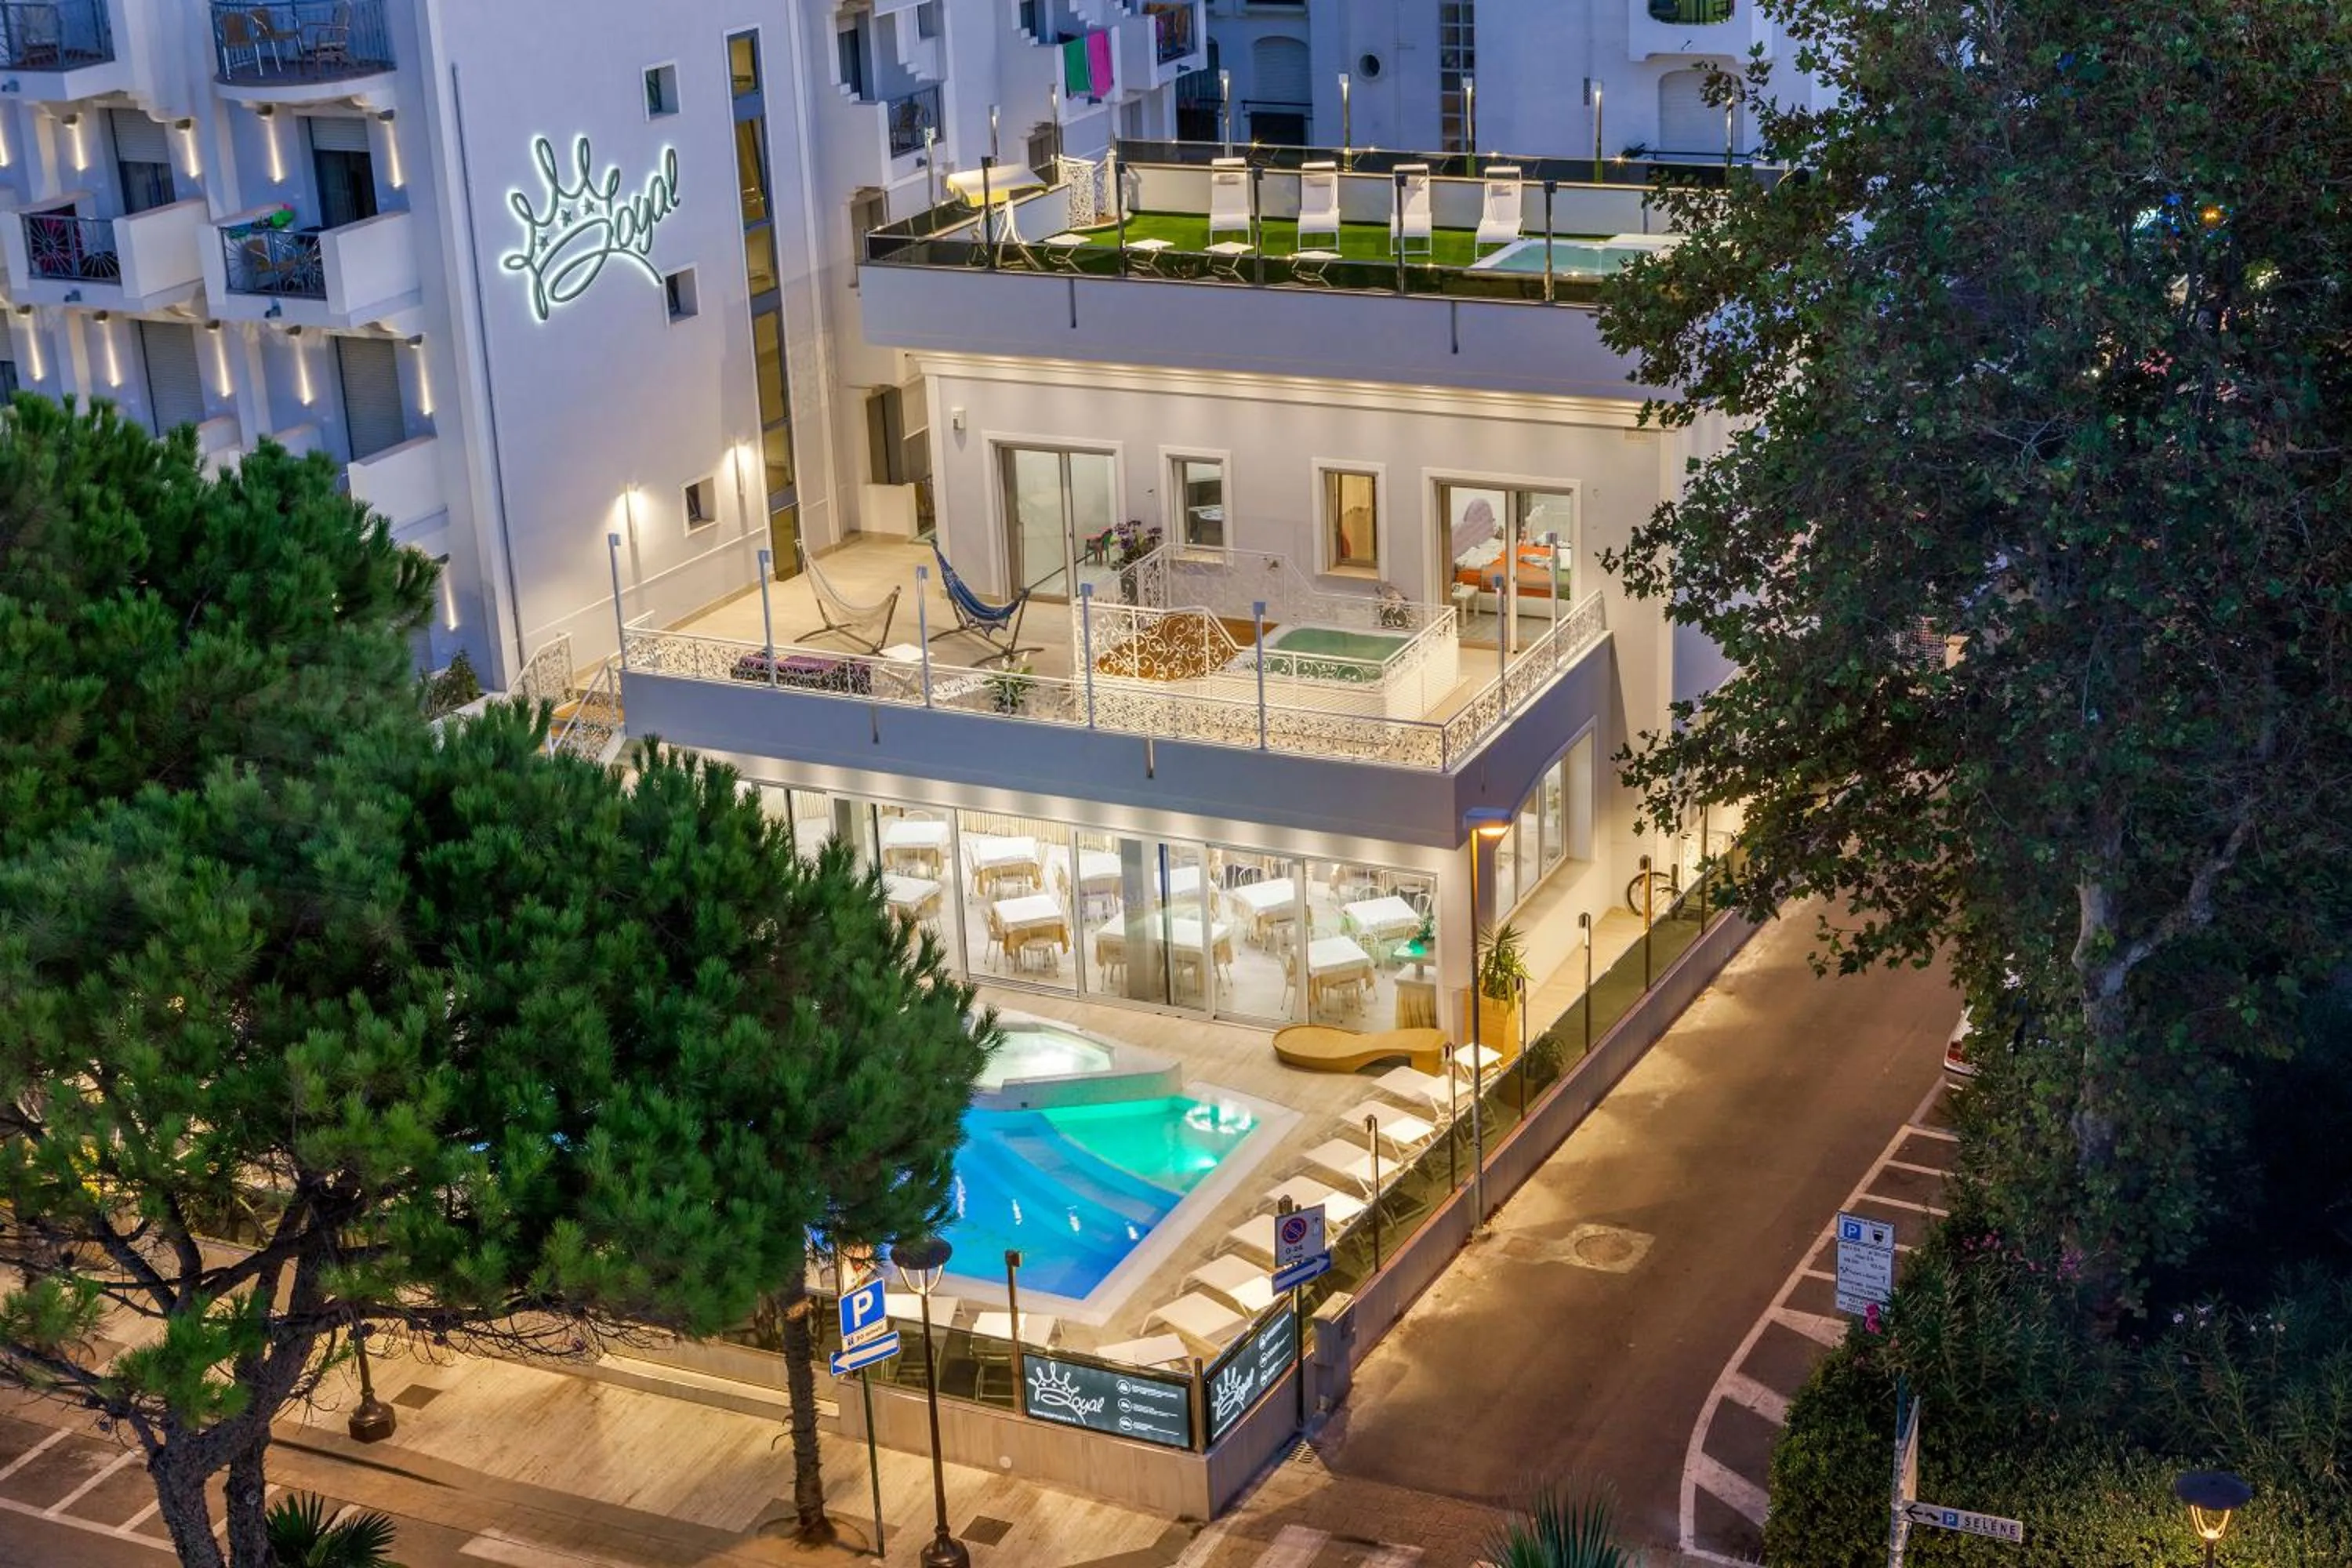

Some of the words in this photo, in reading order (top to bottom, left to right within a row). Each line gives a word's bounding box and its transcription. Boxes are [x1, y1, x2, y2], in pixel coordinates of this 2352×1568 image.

[502, 136, 681, 321] Royal
[853, 1290, 873, 1328] P
[1028, 1362, 1105, 1425] Royal
[1947, 1515, 1955, 1526] P
[1964, 1516, 2016, 1535] SELENE
